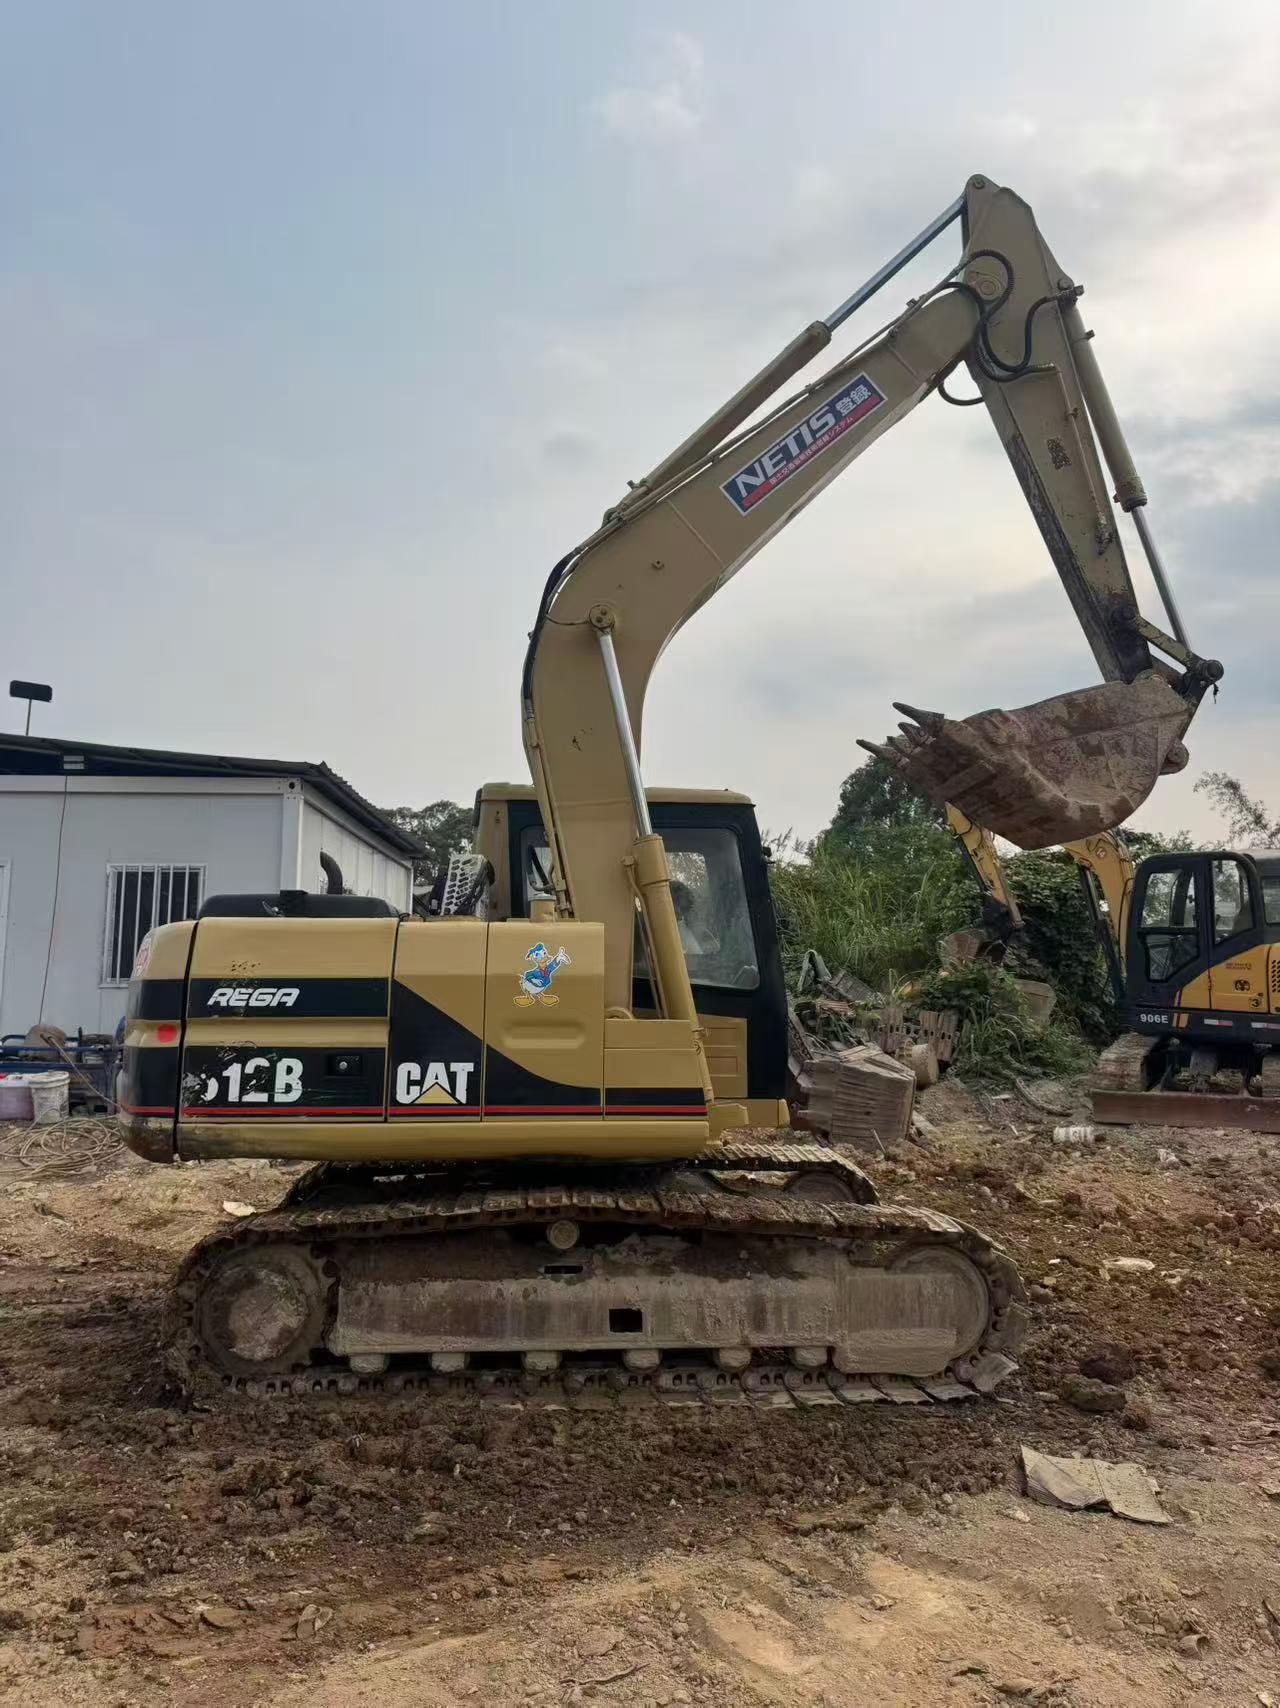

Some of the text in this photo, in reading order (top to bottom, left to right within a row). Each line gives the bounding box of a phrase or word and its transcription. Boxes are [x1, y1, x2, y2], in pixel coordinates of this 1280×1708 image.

[735, 384, 872, 497] NETIS 登録
[207, 988, 300, 1007] REGA
[1140, 1013, 1169, 1024] 906E
[396, 1062, 475, 1104] CAT
